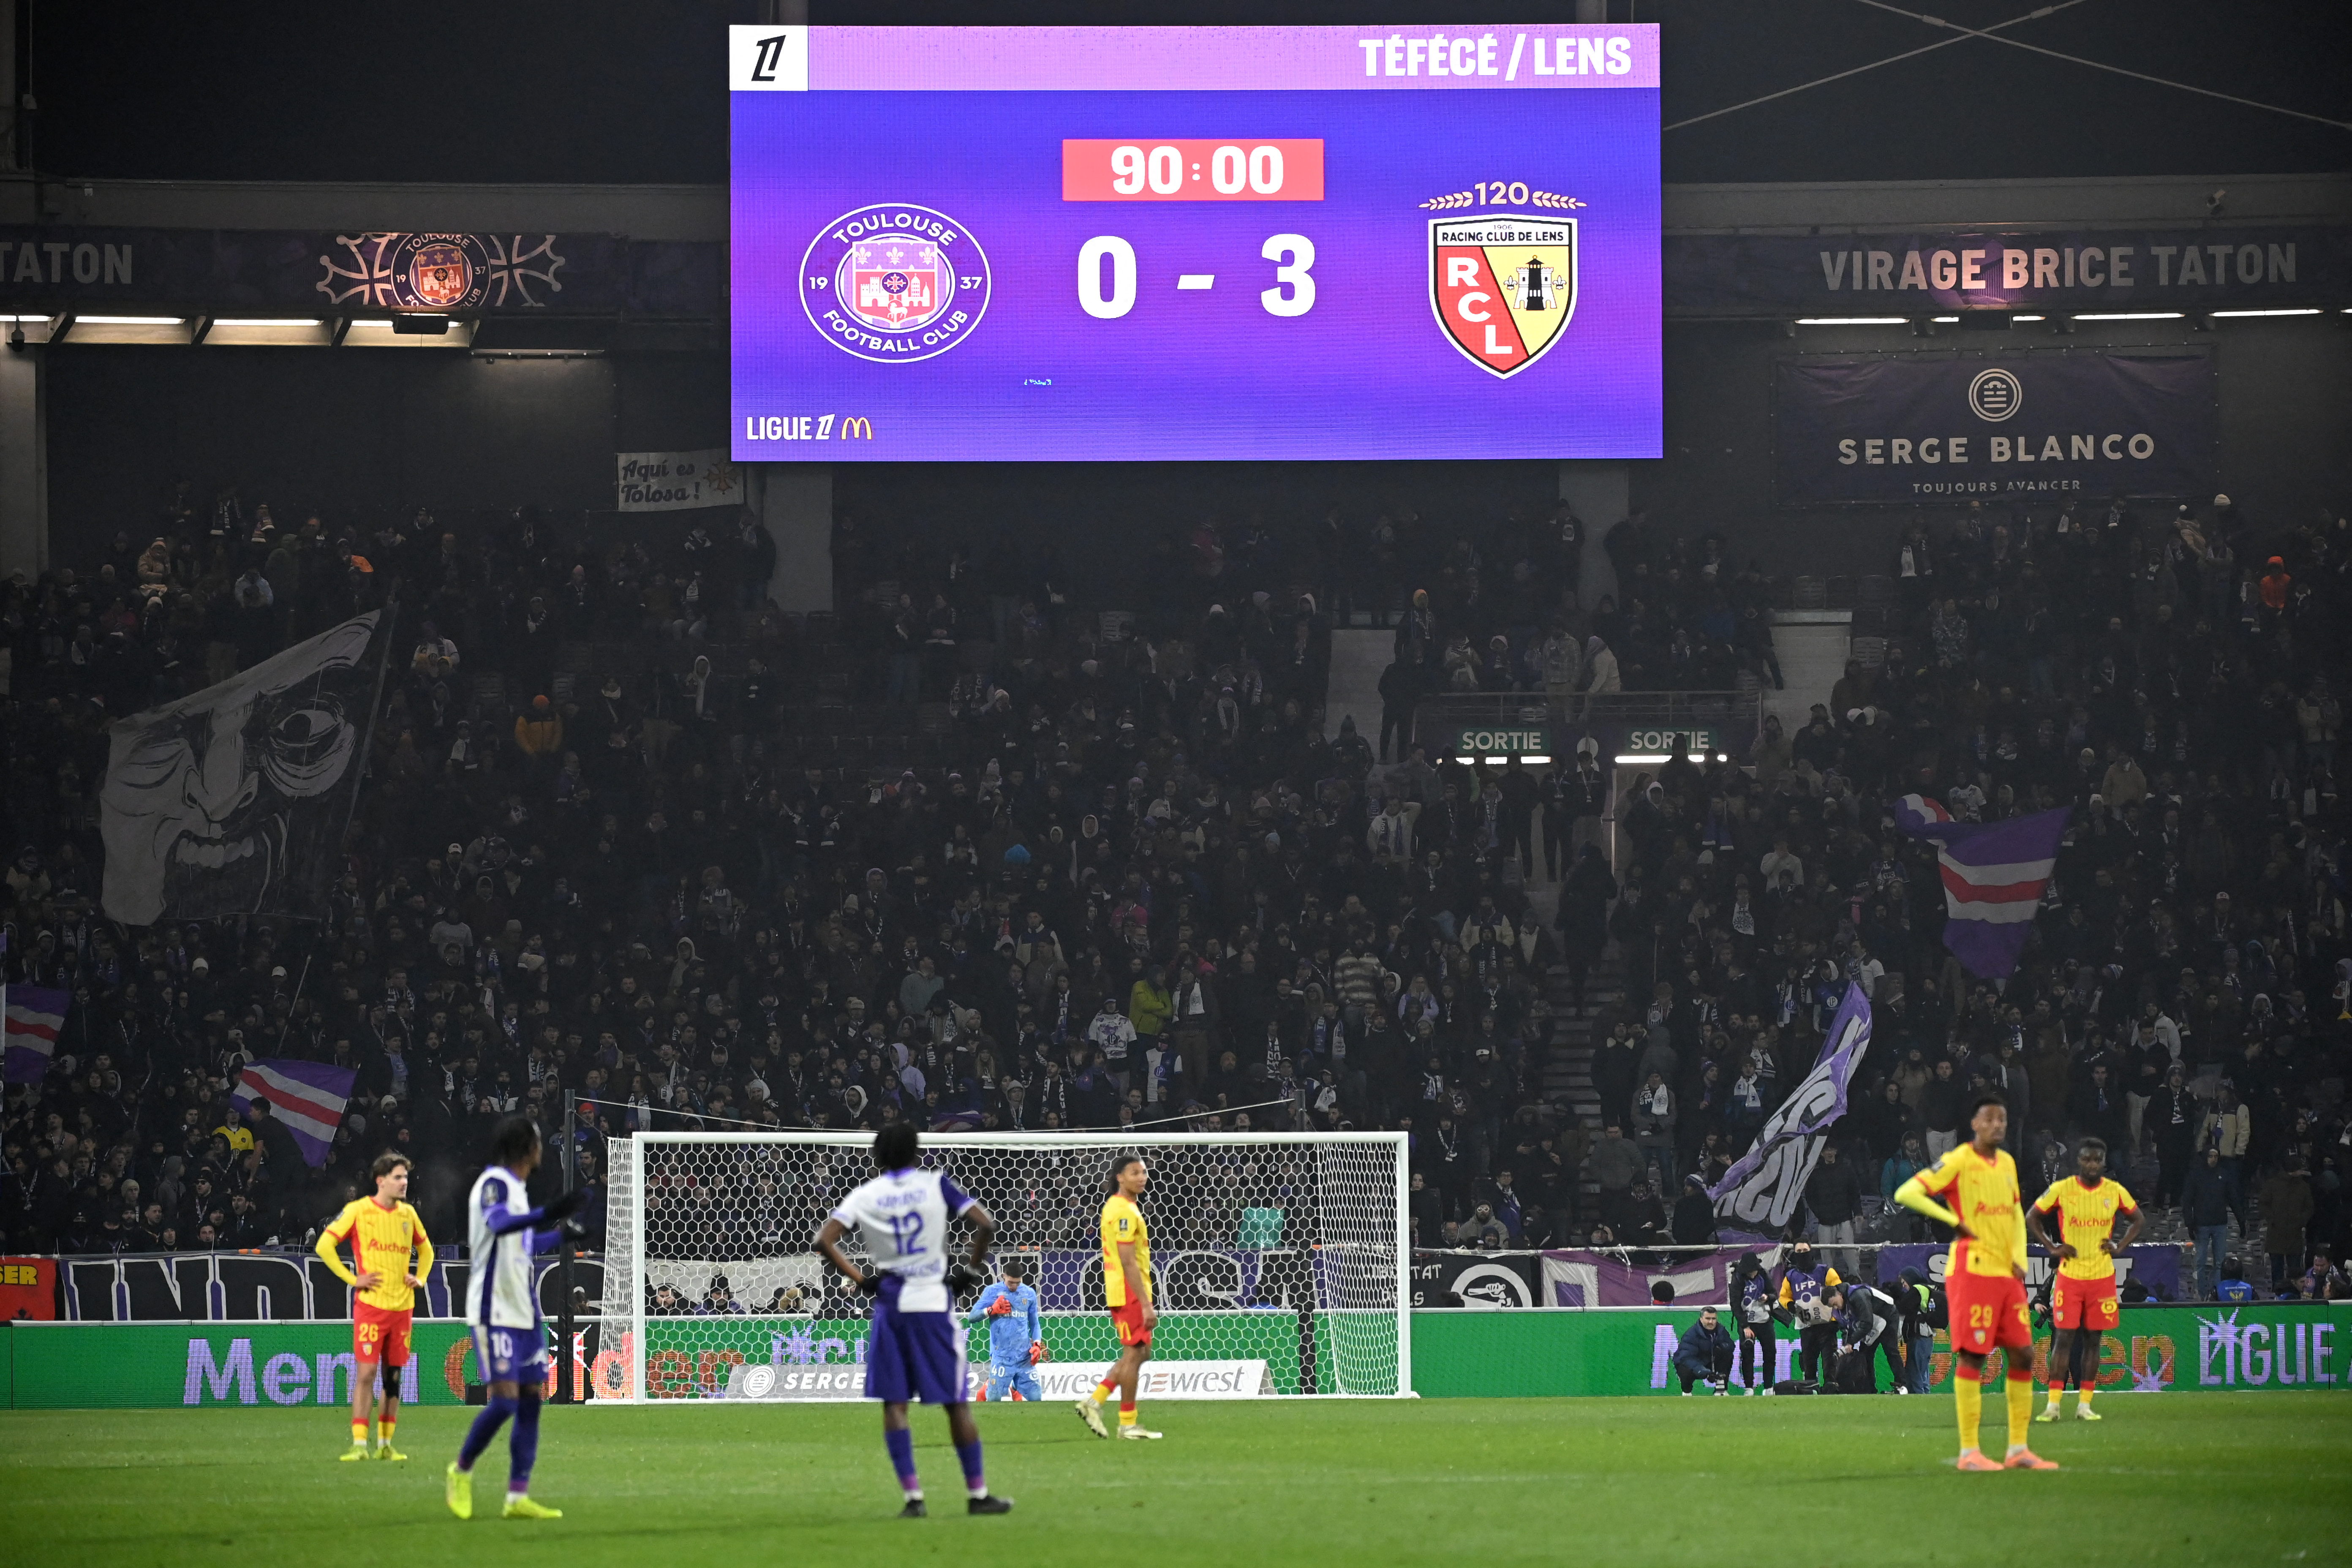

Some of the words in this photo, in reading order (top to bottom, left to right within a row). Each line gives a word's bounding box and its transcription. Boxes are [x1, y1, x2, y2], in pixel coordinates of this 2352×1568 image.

[1358, 33, 1499, 76] TÉFÉCÉ
[1505, 33, 1526, 81] /
[1534, 37, 1631, 75] LENS
[1111, 146, 1283, 194] 90:00
[1474, 181, 1529, 205] 120
[832, 213, 958, 246] TOULOUSE
[1442, 232, 1483, 242] RACING
[1486, 231, 1515, 242] CLUB
[1518, 231, 1532, 241] DE
[1535, 231, 1564, 241] LENS
[474, 266, 486, 275] 37
[1078, 236, 1136, 318] 0
[1261, 234, 1315, 317] 3
[1821, 248, 1986, 291] VIRAGE
[2002, 246, 2135, 290] BRICE
[2150, 243, 2296, 286] TATON
[396, 274, 406, 283] 19
[809, 277, 828, 289] 19
[960, 277, 983, 289] 37
[460, 288, 481, 308] LUB
[823, 309, 921, 352] FOOTBALL
[923, 310, 968, 345] CLUB
[747, 416, 812, 440] LIGUE
[1838, 438, 1968, 465] SERGE
[1990, 434, 2154, 462] BLANCO
[677, 463, 696, 476] es
[621, 484, 690, 503] Tolosa
[1913, 482, 1997, 494] TOUJOURS
[2007, 480, 2080, 490] AVANCER
[1462, 732, 1541, 750] SORTIE
[2070, 1216, 2111, 1227] Auchan
[888, 1211, 927, 1255] 12
[0, 1266, 37, 1285] ER
[1743, 1285, 1758, 1294] FP
[2056, 1290, 2063, 1307] 6
[1970, 1304, 1993, 1328] 29
[359, 1323, 379, 1342] 26
[490, 1331, 514, 1359] 10
[2199, 1323, 2337, 1386] LIGUE
[784, 1372, 867, 1390] SERGE
[991, 1366, 1005, 1377] 40
